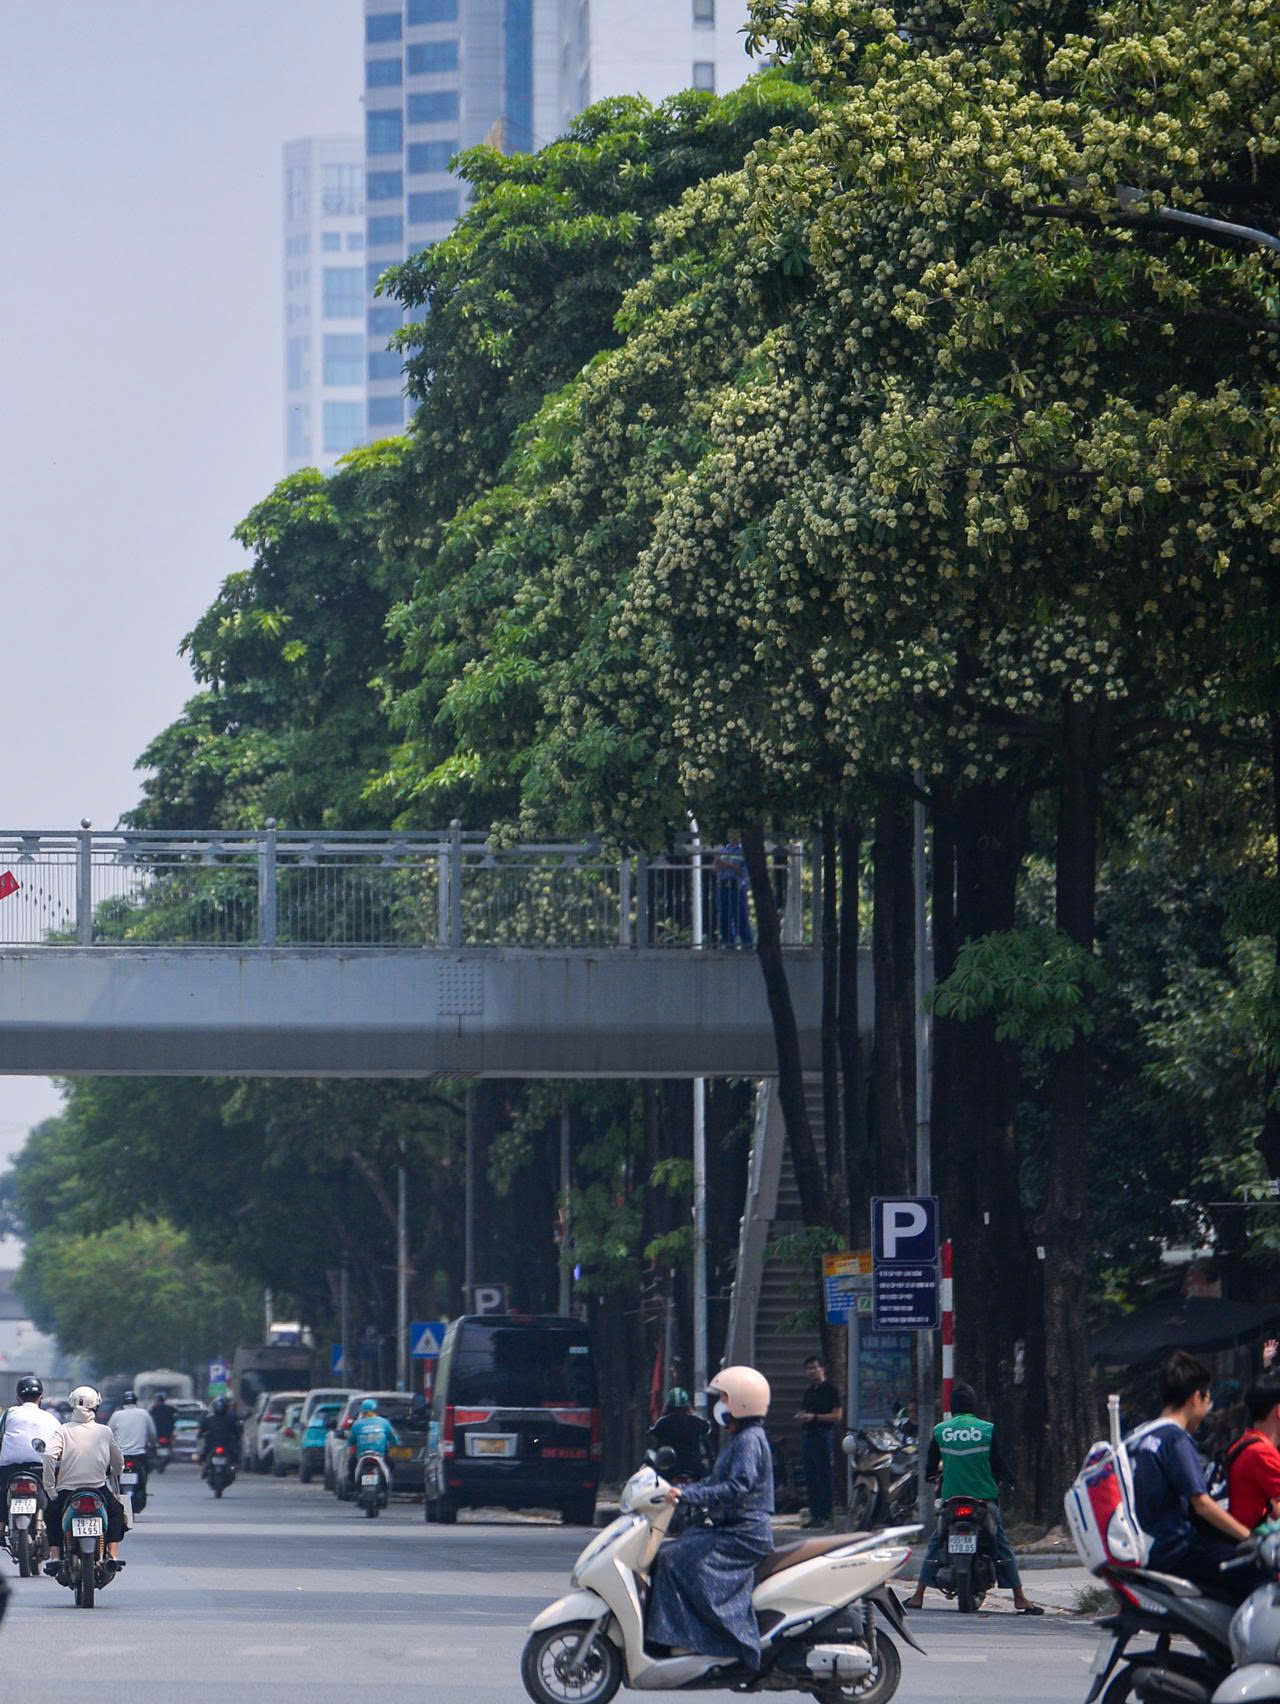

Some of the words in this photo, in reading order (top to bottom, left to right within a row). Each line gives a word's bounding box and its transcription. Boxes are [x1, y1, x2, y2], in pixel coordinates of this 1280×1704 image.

[883, 1202, 928, 1258] P
[474, 1288, 500, 1315] P
[941, 1427, 983, 1442] Grab
